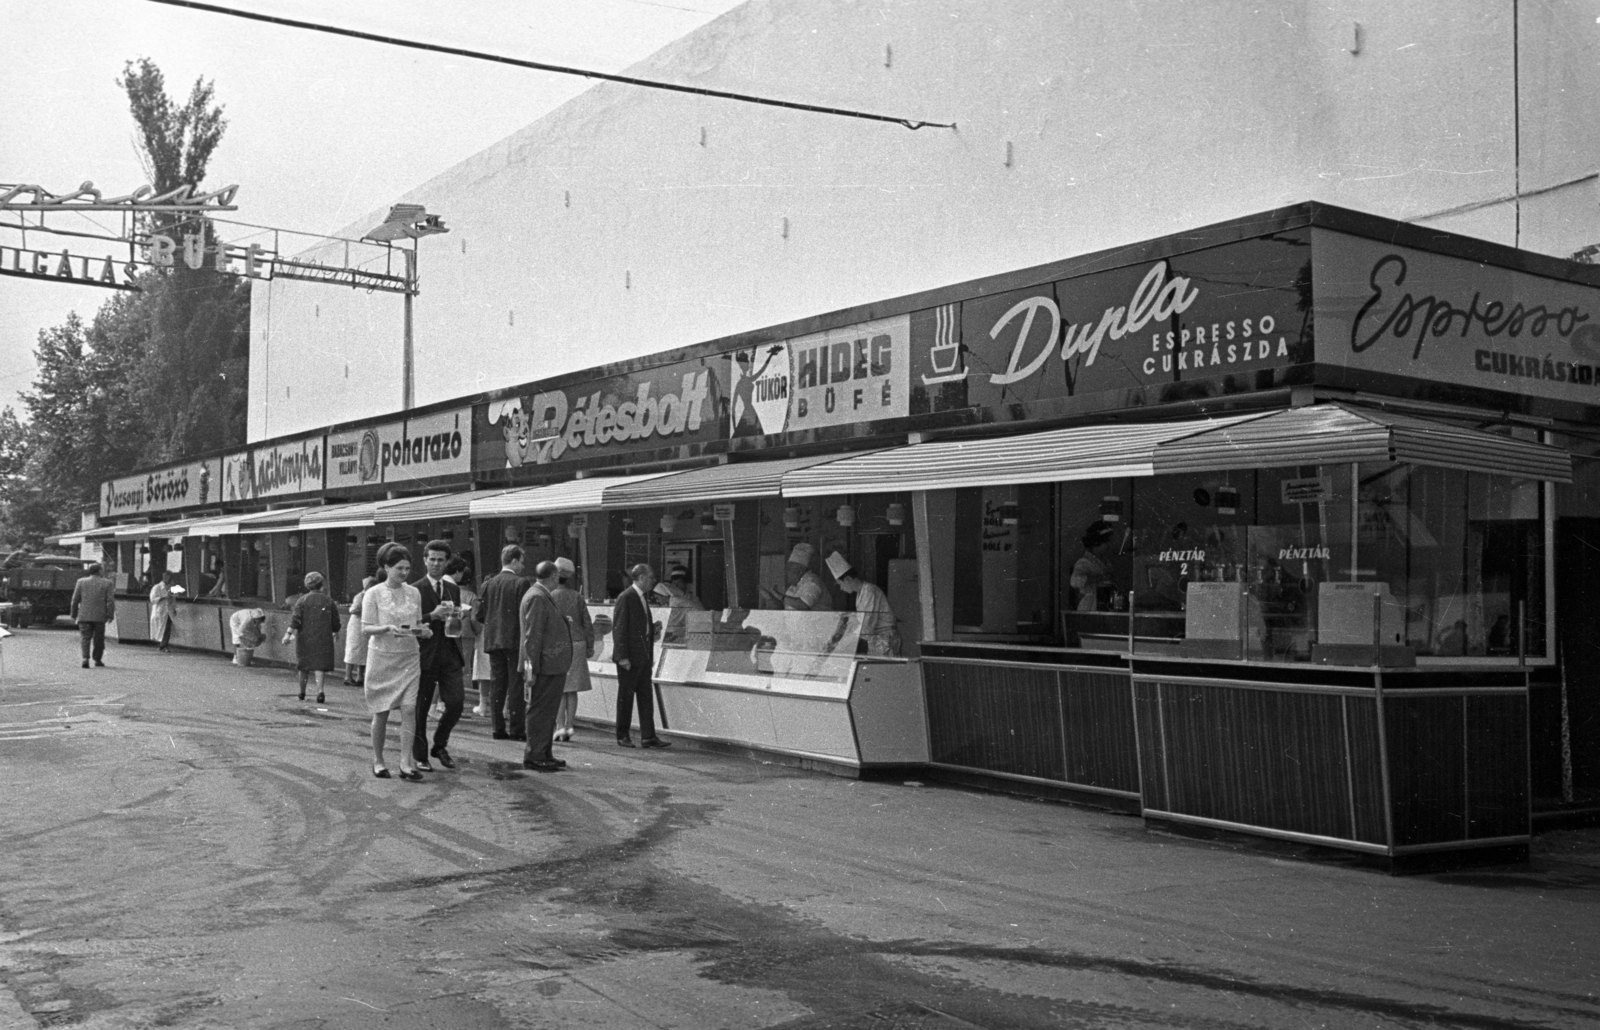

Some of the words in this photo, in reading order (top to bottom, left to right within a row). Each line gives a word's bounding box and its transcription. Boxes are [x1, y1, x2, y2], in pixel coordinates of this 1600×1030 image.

[0, 248, 139, 287] LGÁLÁS
[989, 261, 1199, 385] Dupla
[1351, 254, 1590, 360] Espresso
[1152, 315, 1275, 352] ESPRESSO
[798, 334, 892, 389] HIDEG
[1143, 336, 1288, 375] CUKRÁSZDA
[755, 375, 787, 402] TÜKÖR
[798, 381, 892, 418] BÜFÉ
[529, 369, 708, 462] Rétesbolt
[381, 414, 463, 483] poharazó
[1159, 547, 1205, 563] PÉNZTÁR
[1181, 563, 1188, 575] 2
[1279, 544, 1330, 560] PÉNZTÁR
